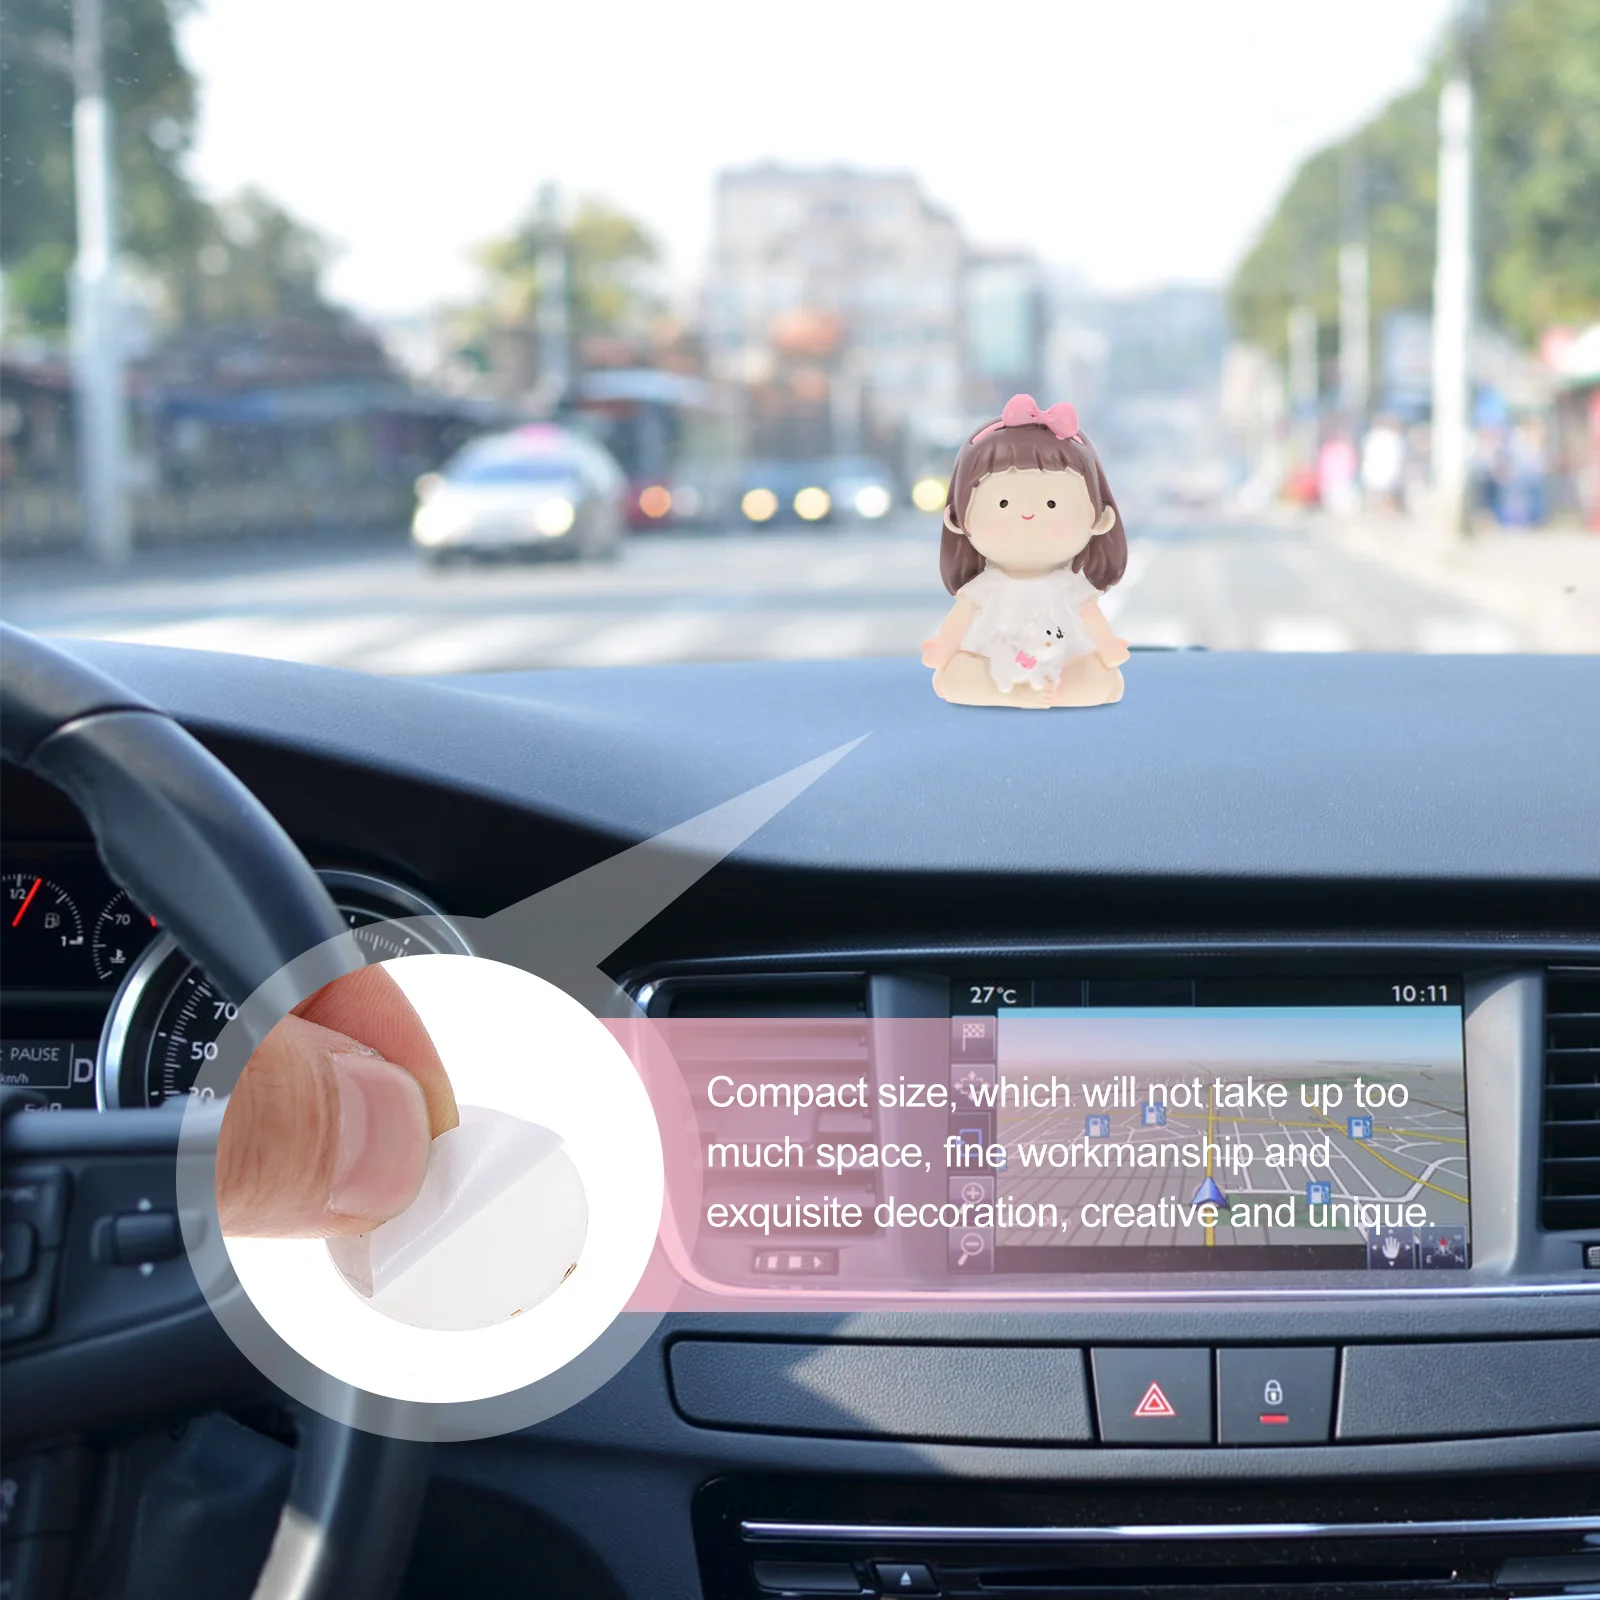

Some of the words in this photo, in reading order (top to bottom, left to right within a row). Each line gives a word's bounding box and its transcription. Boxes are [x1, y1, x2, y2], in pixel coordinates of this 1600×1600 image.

[9, 888, 27, 900] 1/2
[115, 913, 131, 925] 70
[970, 986, 1017, 1004] 27°C
[1391, 985, 1448, 1003] 10:11
[213, 1001, 239, 1021] 70
[10, 1047, 60, 1062] PAUSE
[190, 1041, 219, 1061] 50
[73, 1058, 95, 1083] D
